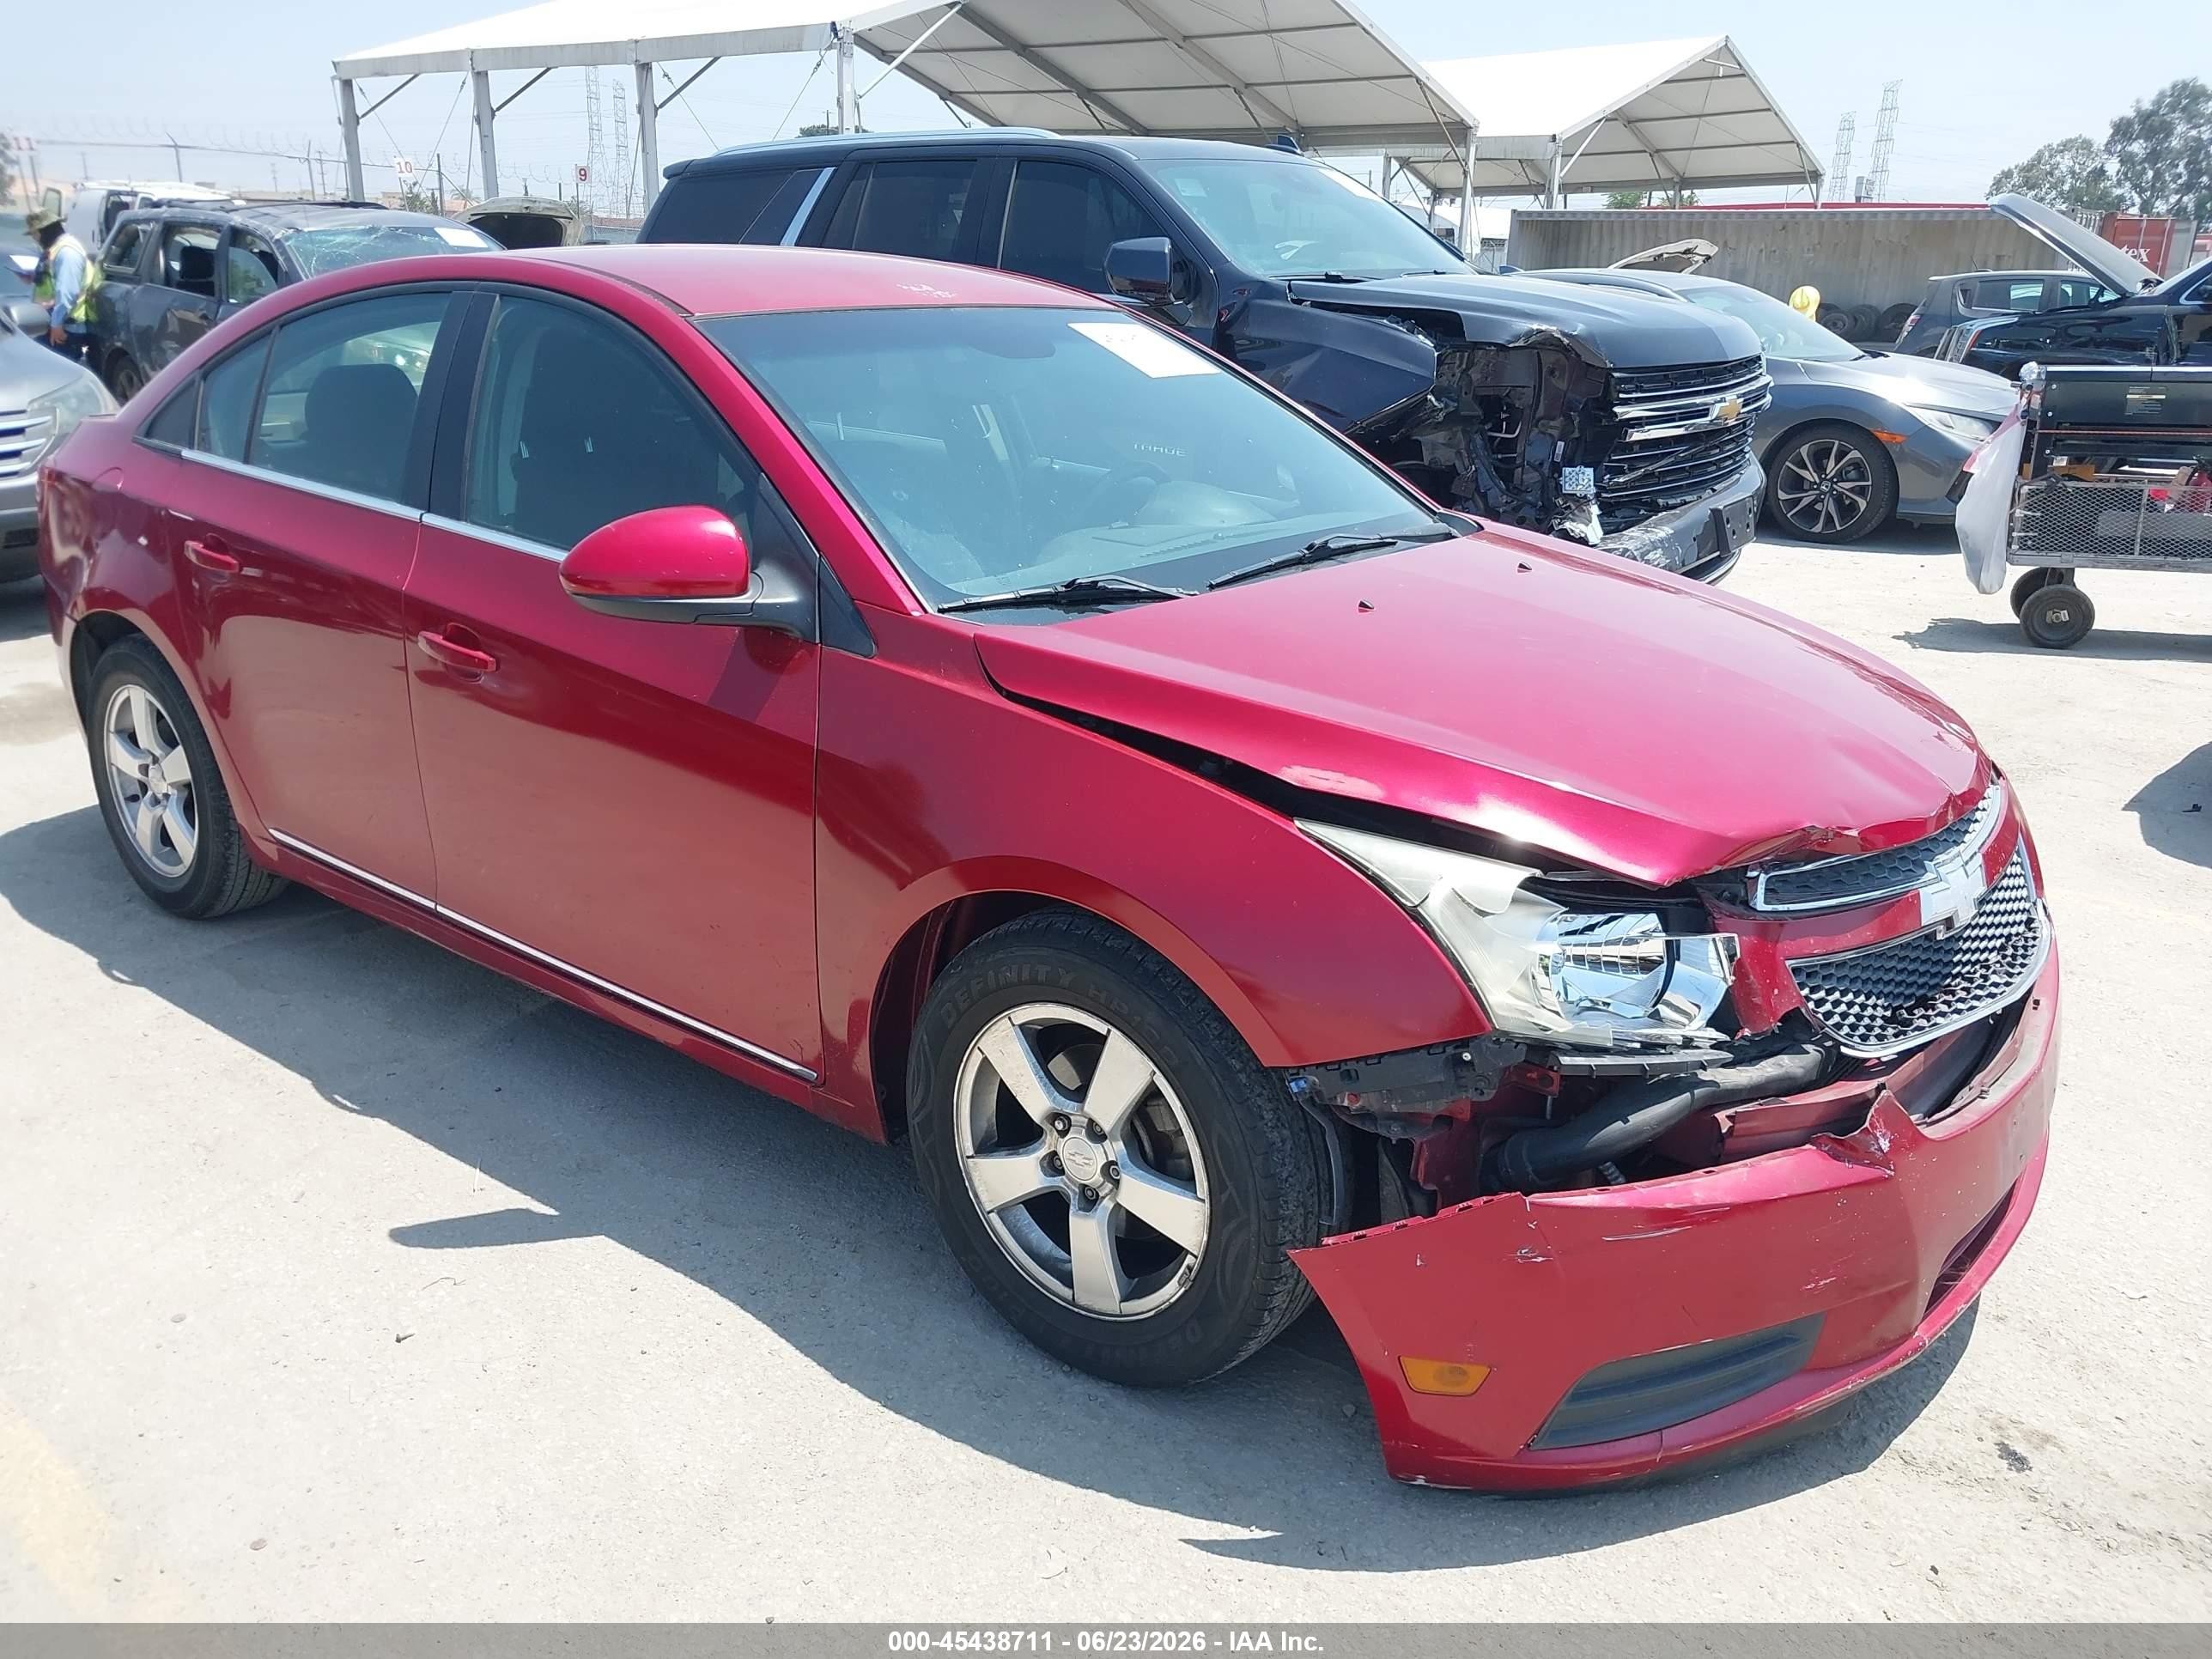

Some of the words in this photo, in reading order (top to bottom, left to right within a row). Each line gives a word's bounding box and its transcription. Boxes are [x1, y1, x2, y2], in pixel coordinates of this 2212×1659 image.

[396, 161, 413, 173] 10
[578, 167, 587, 182] 9
[938, 962, 1079, 1028] DEFINITY
